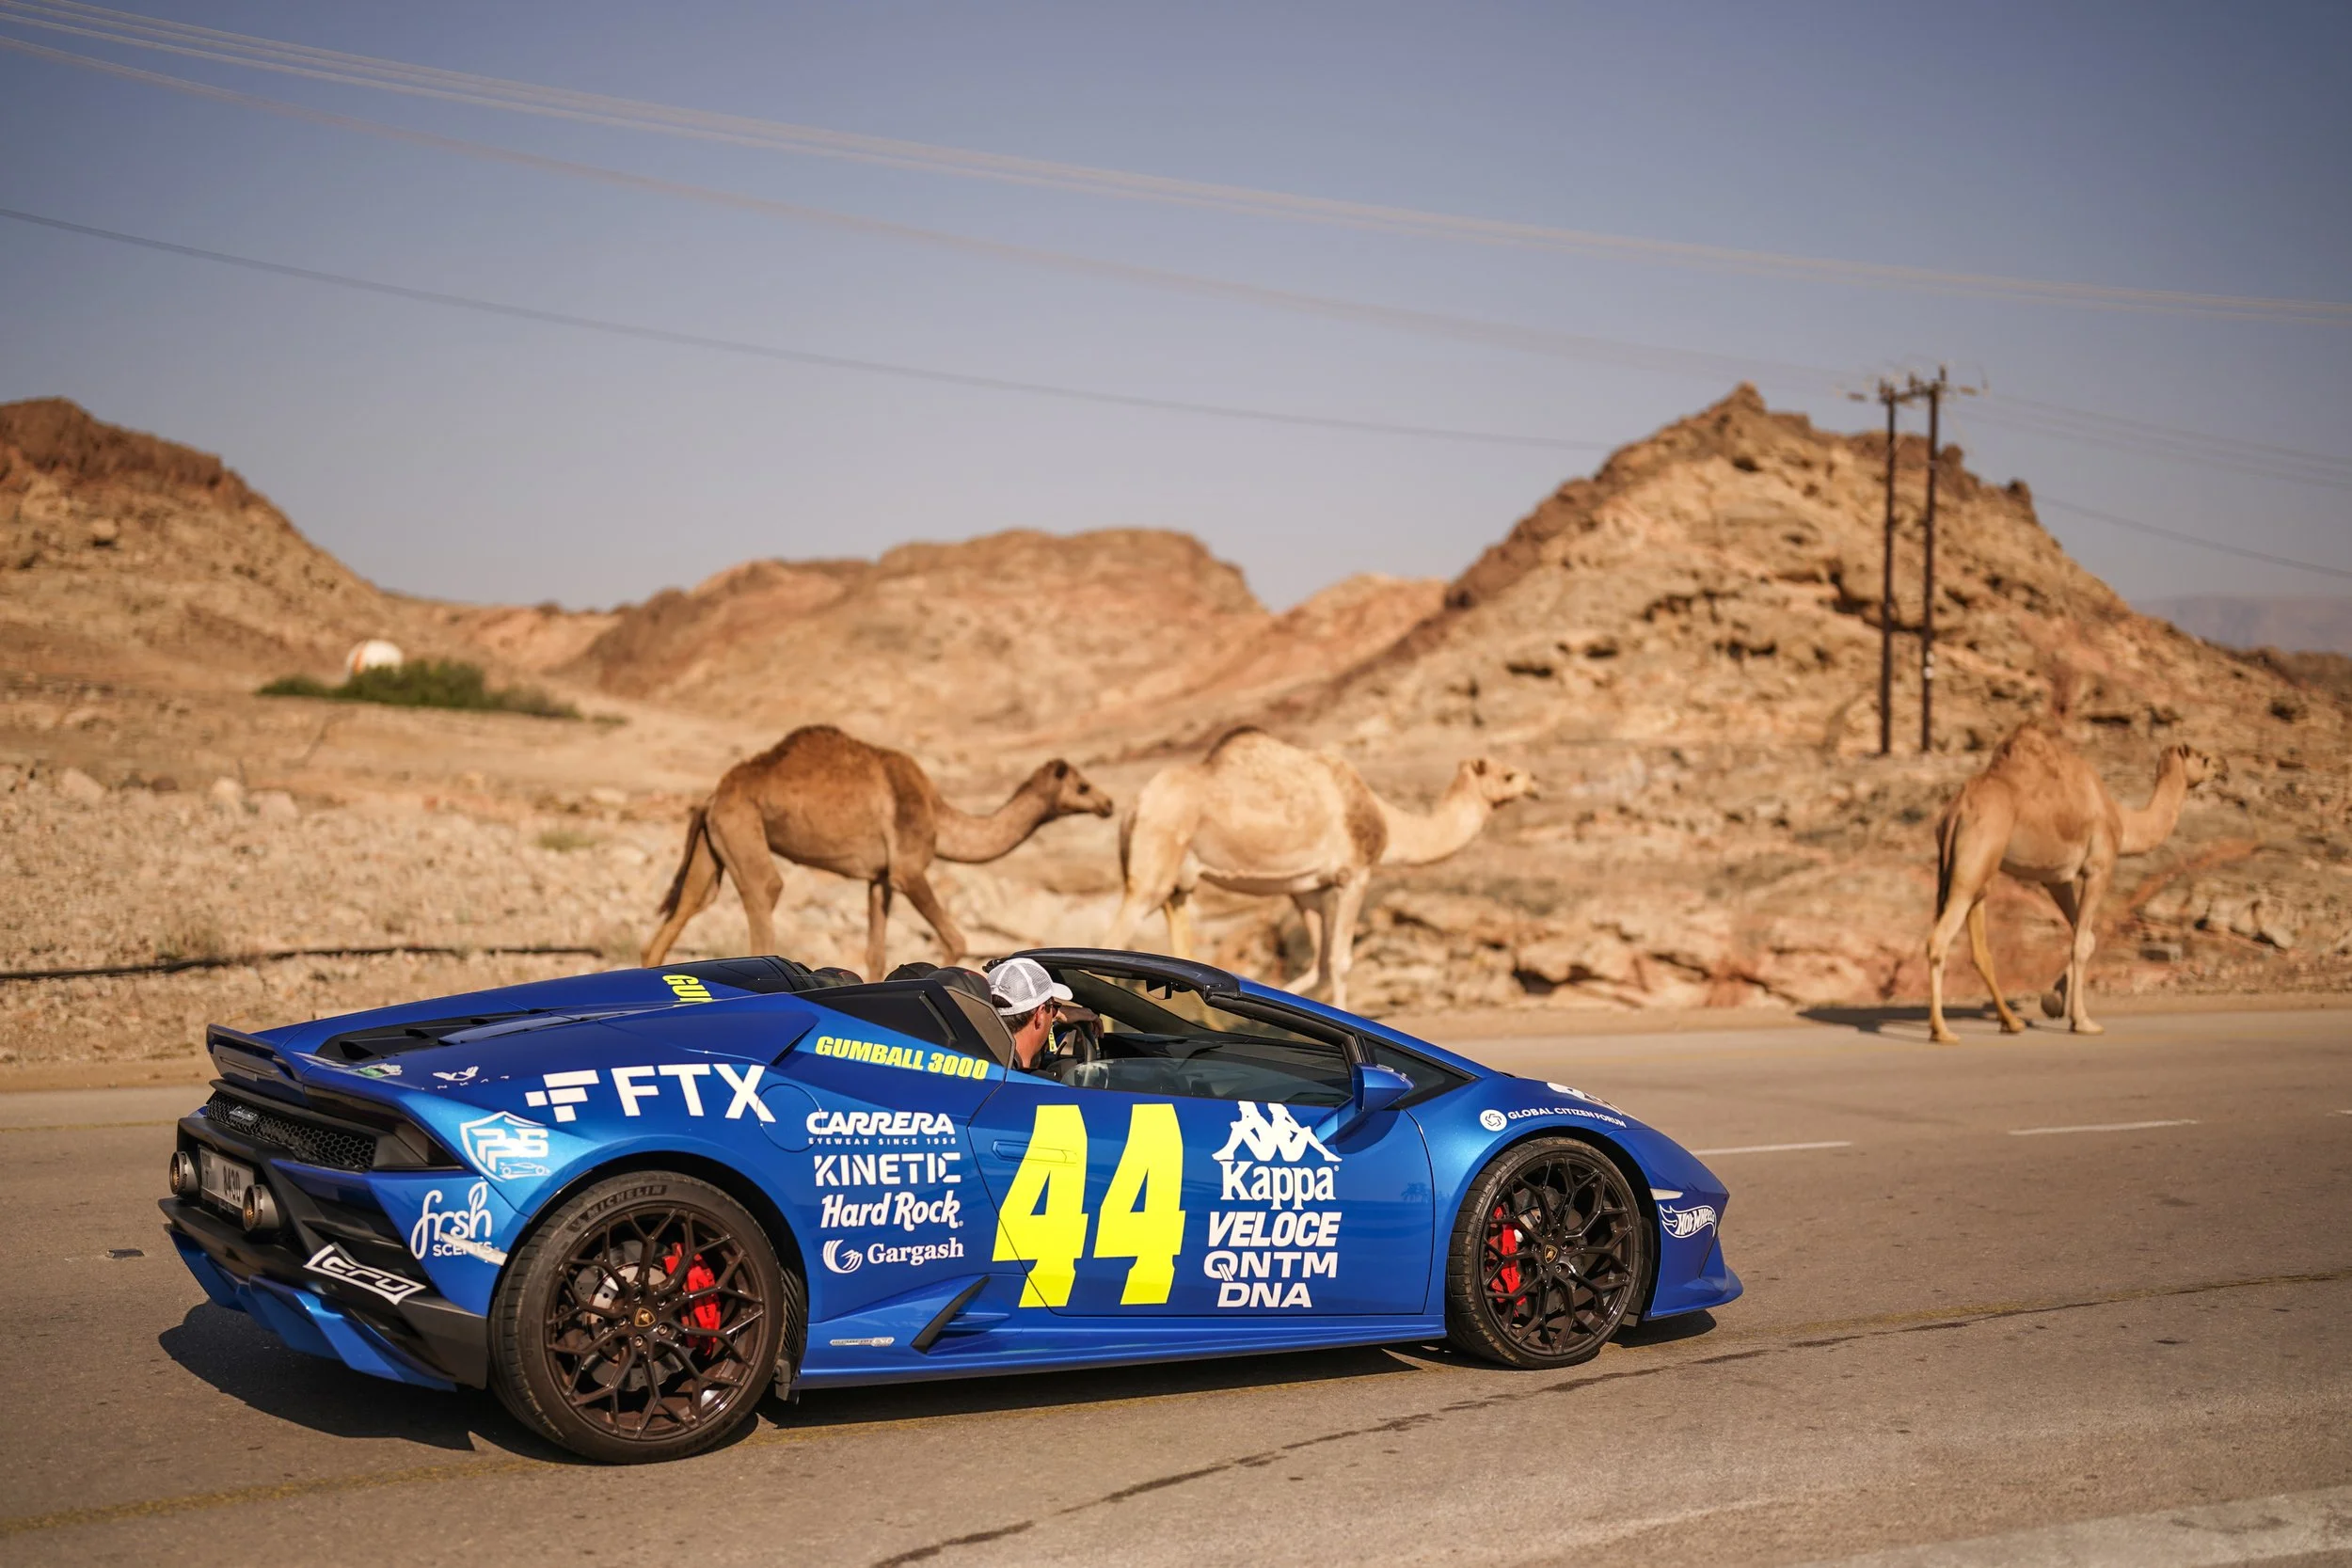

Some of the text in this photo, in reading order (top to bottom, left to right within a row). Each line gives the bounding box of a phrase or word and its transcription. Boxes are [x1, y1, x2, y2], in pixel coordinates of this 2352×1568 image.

[815, 1036, 990, 1080] GUMBALL 3000
[611, 1063, 777, 1124] FTX
[805, 1111, 956, 1136] CARRERA
[1507, 1107, 1627, 1128] GLOBAL CITIZEN FORUM
[808, 1137, 869, 1146] EYEWEAR
[879, 1137, 917, 1146] SINCE
[814, 1152, 961, 1187] KINETIC
[1220, 1161, 1337, 1211] Kappa
[820, 1192, 892, 1228] Hard
[992, 1103, 1185, 1308] 44
[1207, 1211, 1343, 1247] VELOCE
[867, 1237, 964, 1266] Gargash
[1203, 1250, 1338, 1282] QNTM
[1216, 1282, 1313, 1308] DNA
